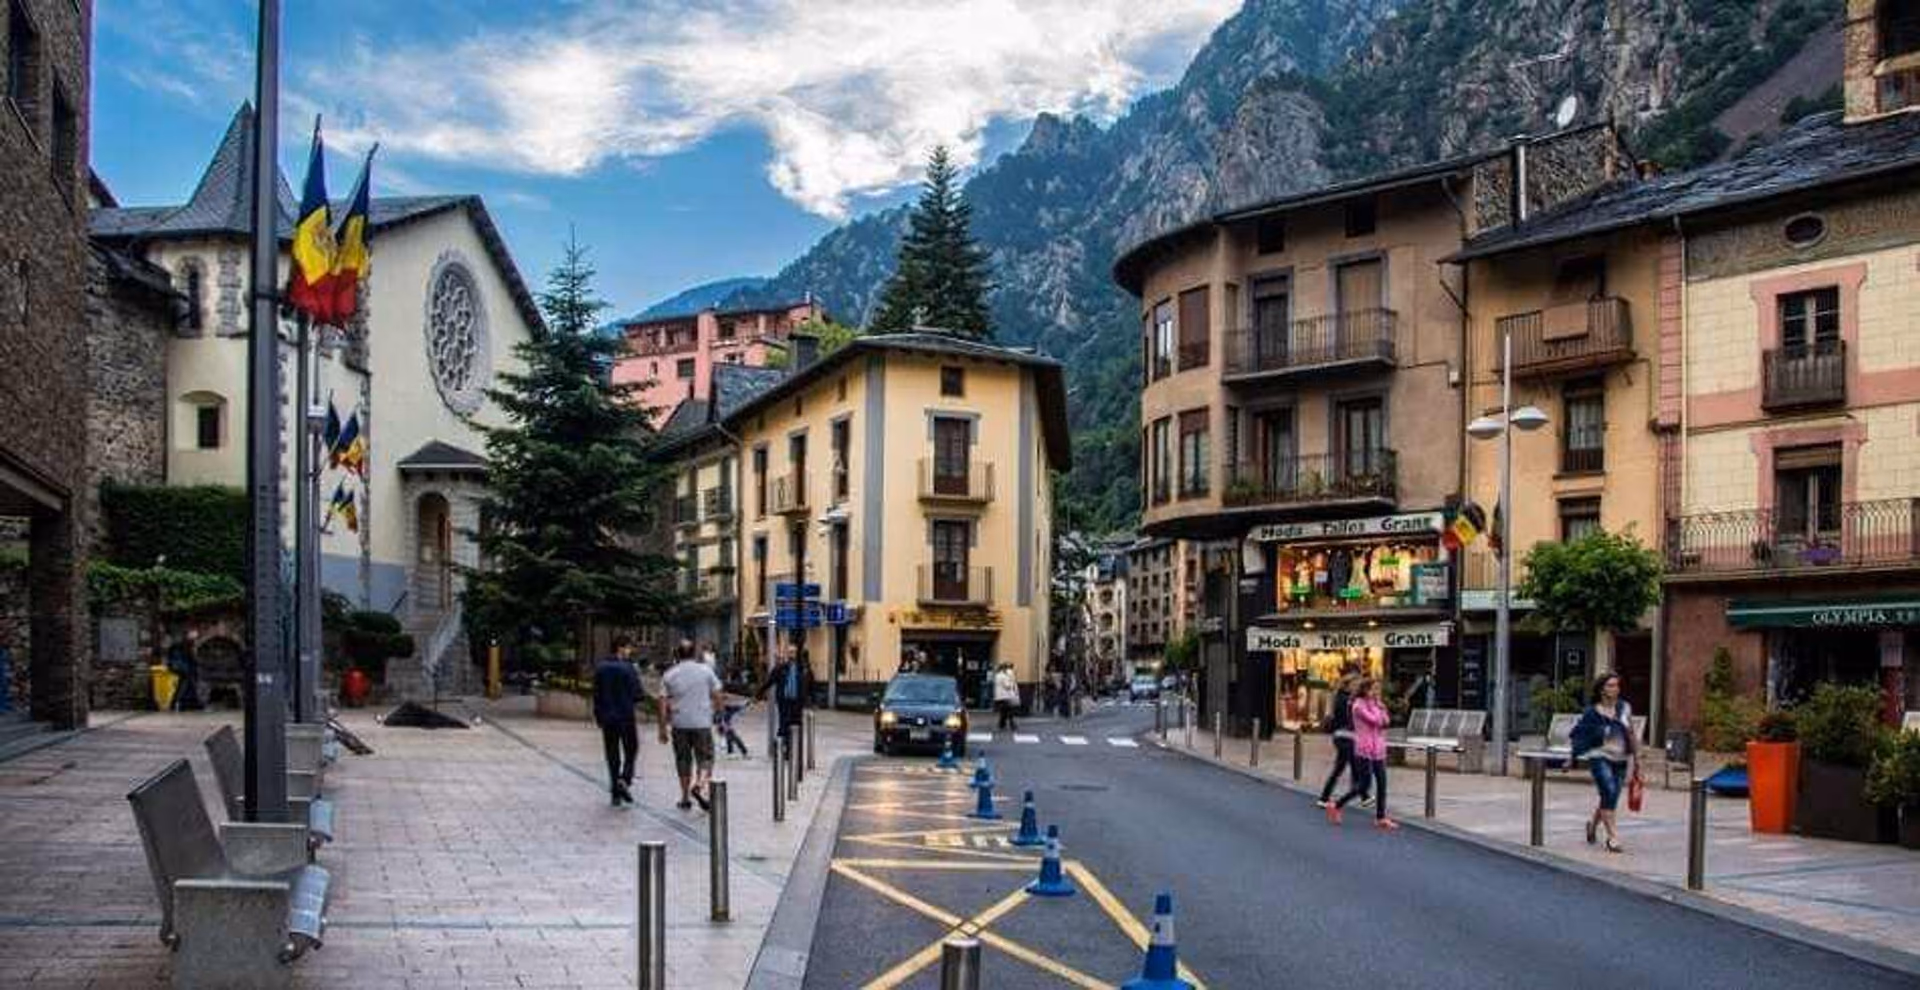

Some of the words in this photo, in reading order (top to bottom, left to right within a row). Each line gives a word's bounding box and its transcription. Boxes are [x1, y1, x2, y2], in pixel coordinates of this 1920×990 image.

[1260, 526, 1303, 539] Moda
[1322, 522, 1366, 536] Talles
[1381, 516, 1431, 531] Grant
[1813, 609, 1891, 625] OLYMPIA
[1258, 635, 1301, 648] Moda
[1321, 634, 1366, 647] Talles
[1384, 632, 1432, 646] Grant
